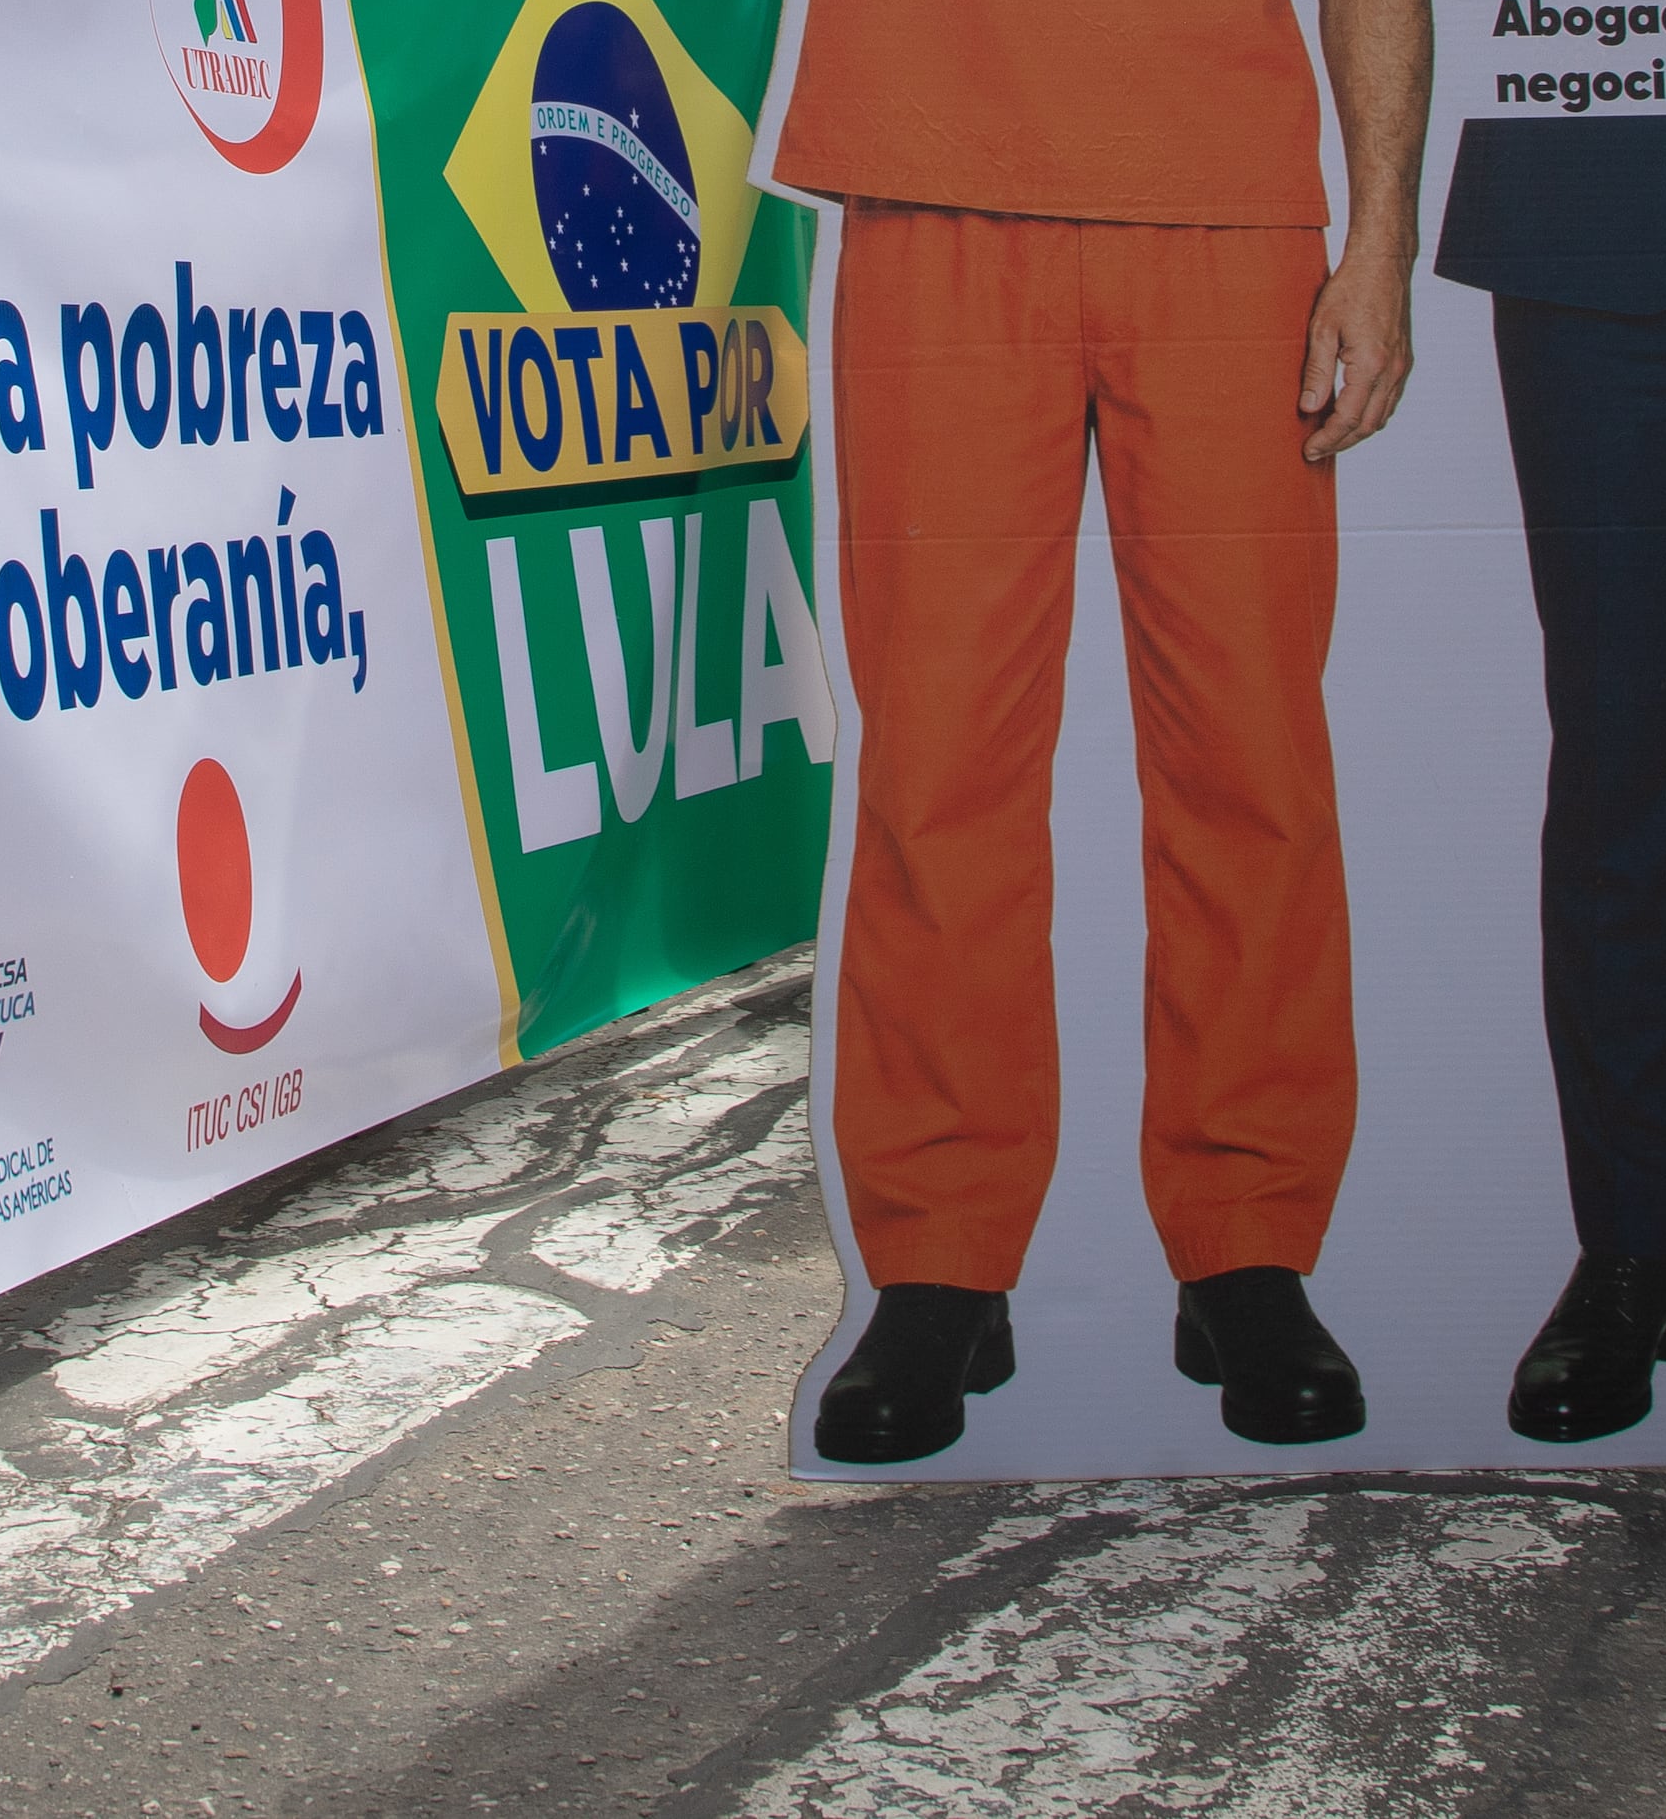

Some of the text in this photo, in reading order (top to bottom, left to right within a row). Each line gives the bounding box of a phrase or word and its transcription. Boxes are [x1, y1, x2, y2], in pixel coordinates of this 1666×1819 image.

[181, 47, 272, 100] UTRADEC
[537, 107, 691, 217] ORDEM E PROGRESSO
[61, 261, 385, 490] pobreza
[459, 319, 783, 475] VOTA POR
[486, 498, 836, 854] LULA
[37, 1138, 54, 1168] DE
[187, 1069, 302, 1152] ITUC CSI IGB
[13, 1170, 72, 1218] AMÉRICAS
